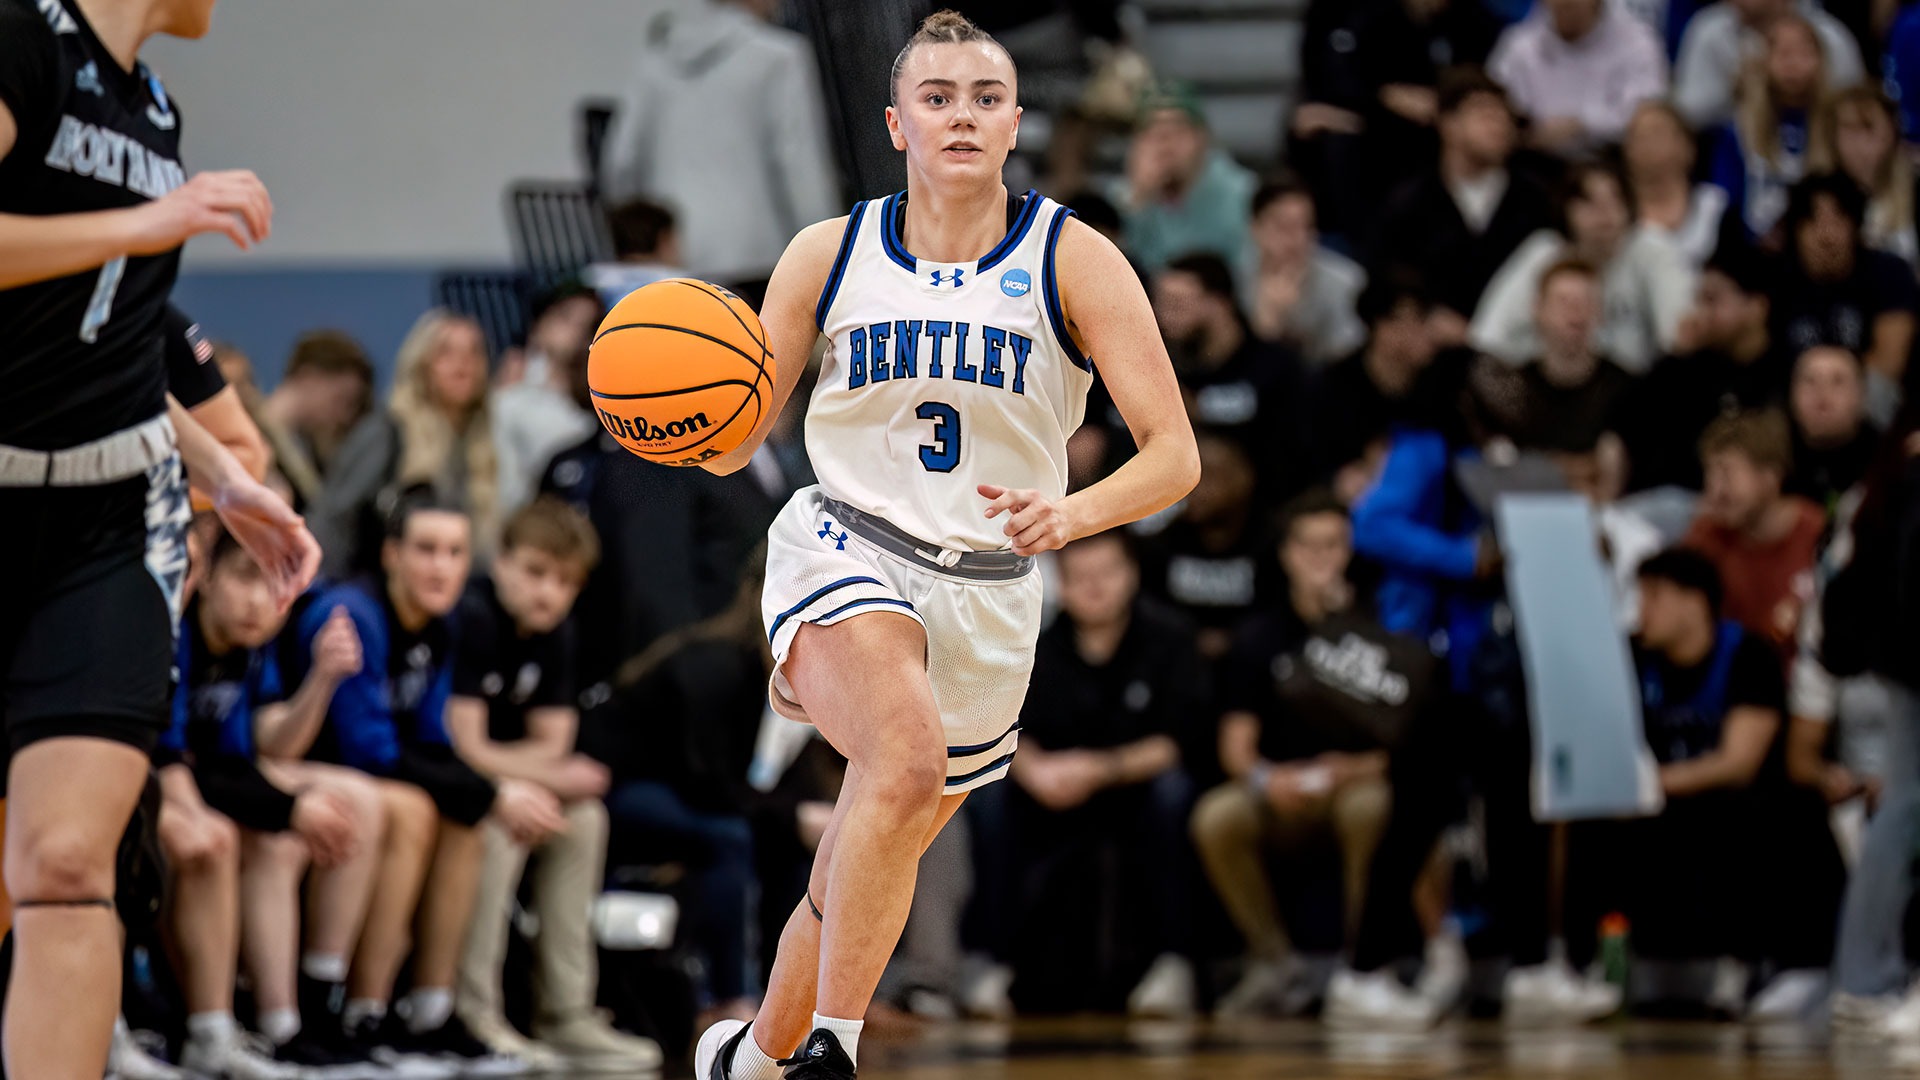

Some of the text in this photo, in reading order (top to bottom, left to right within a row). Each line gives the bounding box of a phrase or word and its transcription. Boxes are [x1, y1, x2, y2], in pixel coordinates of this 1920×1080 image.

[1003, 280, 1029, 291] NCAA
[849, 320, 1032, 395] BENTLEY
[598, 407, 712, 441] Wilson
[915, 401, 962, 473] 3
